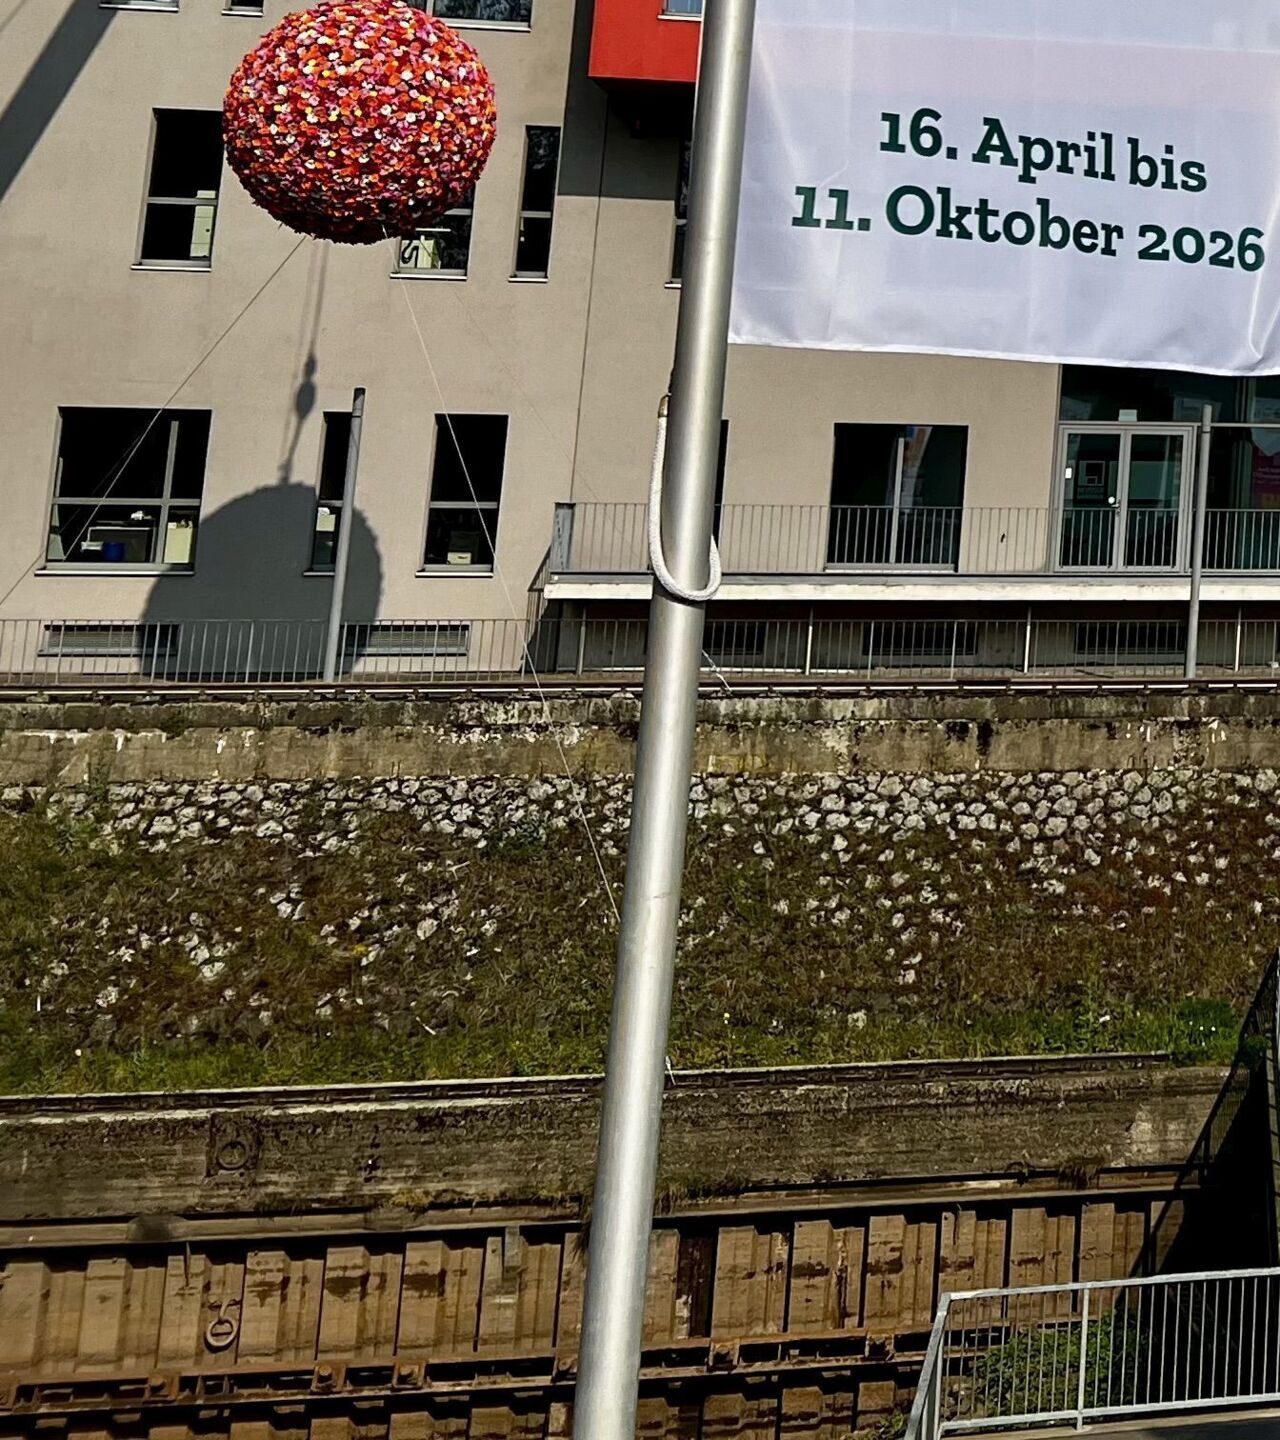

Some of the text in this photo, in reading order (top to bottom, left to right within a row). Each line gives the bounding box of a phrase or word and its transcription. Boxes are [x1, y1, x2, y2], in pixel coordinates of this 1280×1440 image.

[879, 107, 1208, 193] 16. April bis
[791, 184, 1266, 273] 11. Oktober 2026
